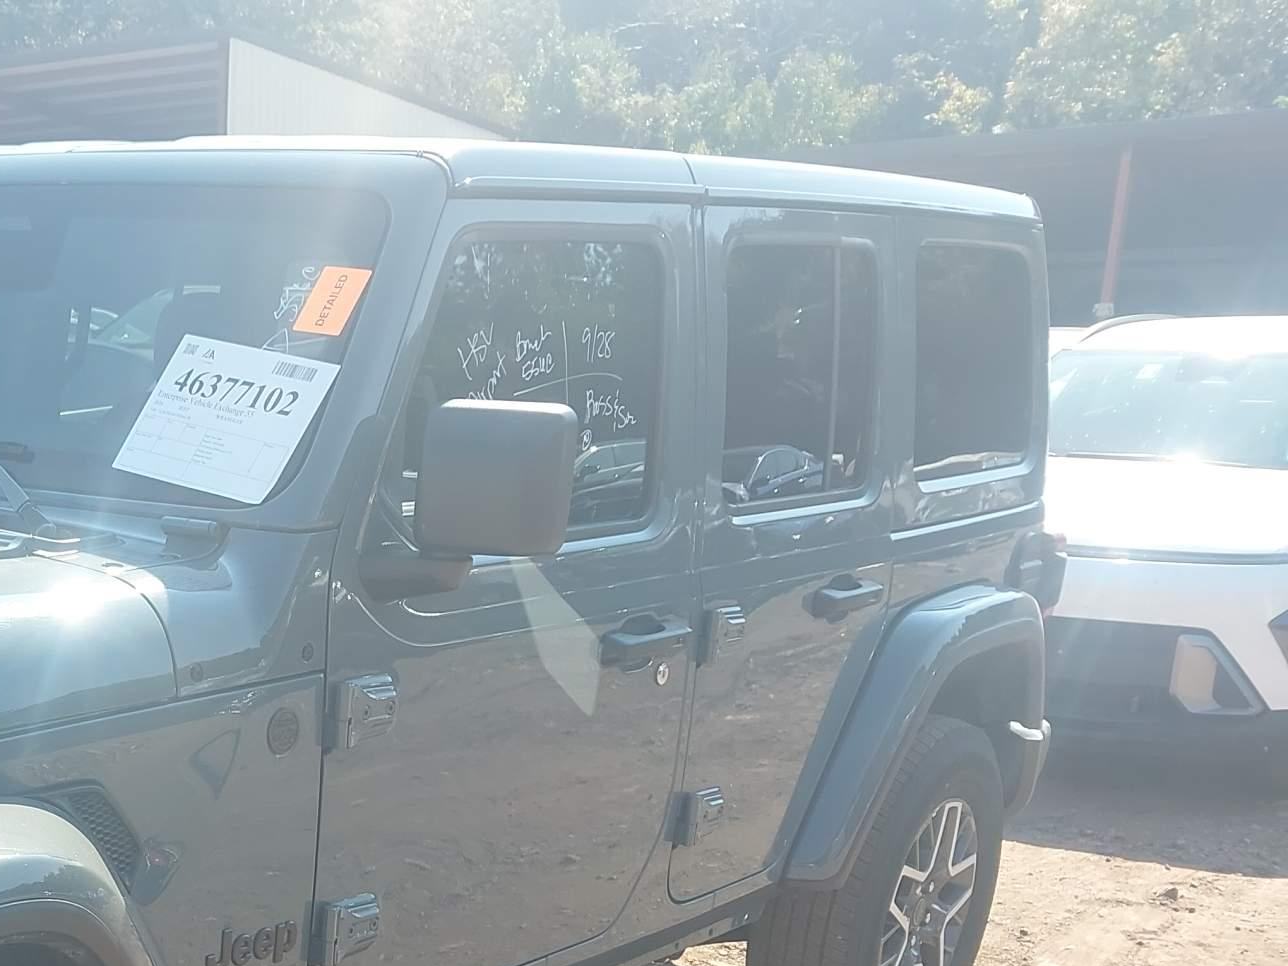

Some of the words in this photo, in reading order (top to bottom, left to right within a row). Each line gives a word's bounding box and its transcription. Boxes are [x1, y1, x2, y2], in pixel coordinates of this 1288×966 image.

[315, 274, 348, 327] DETAILED
[581, 323, 616, 363] 9/28
[174, 368, 299, 416] 46377102
